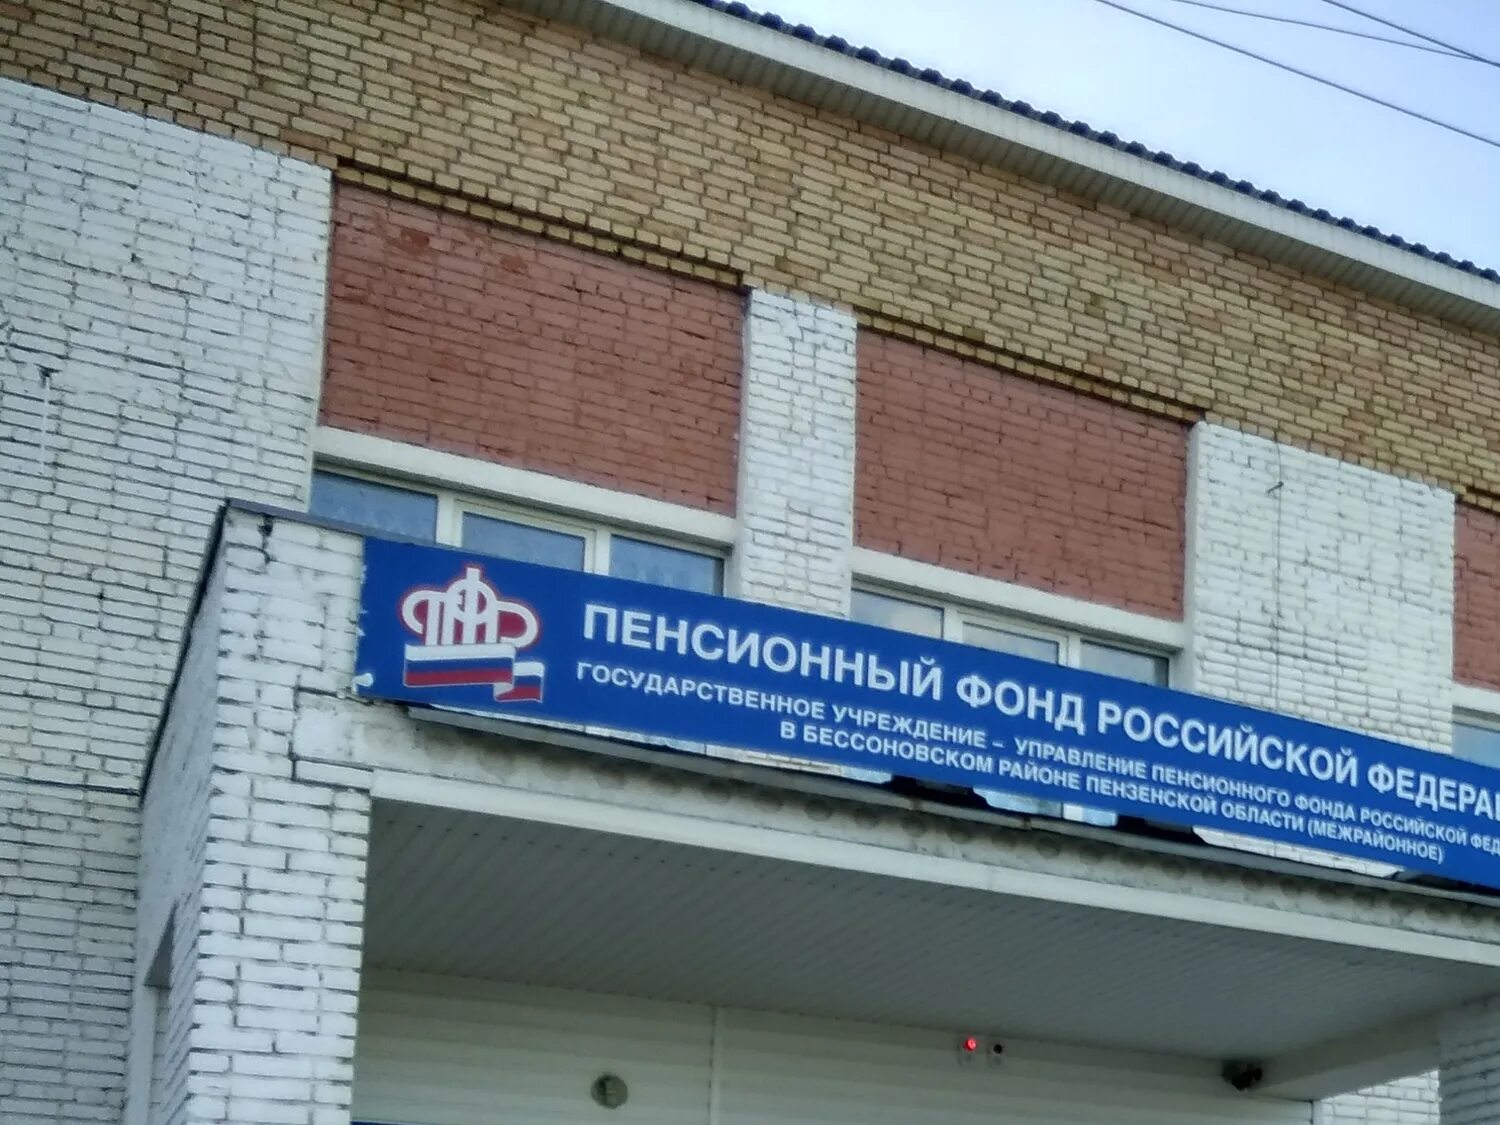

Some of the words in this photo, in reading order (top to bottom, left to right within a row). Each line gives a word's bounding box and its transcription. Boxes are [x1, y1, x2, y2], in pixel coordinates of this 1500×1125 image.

[577, 661, 826, 721] ГОСУДАРСТВЕННОЕ
[832, 704, 987, 749] УЧРЕЖДЕНИЕ
[1014, 738, 1147, 780] УПРАВЛЕНИЕ
[1151, 764, 1291, 807] ПЕНСИОННОГО
[1294, 794, 1357, 821] ФОНДА
[1360, 808, 1467, 846] РОССИЙСКОЙ
[583, 603, 943, 701] ПЕНСИОННЫЙ
[956, 674, 1086, 736] ФОНД
[1098, 700, 1358, 787] РОССИЙСКОЙ
[780, 720, 797, 739] В
[803, 724, 994, 773] БЕССОНОВСКОМ
[998, 759, 1080, 790] РАЙОНЕ
[1086, 775, 1218, 815] ПЕНЗЕНСКОЙ
[1220, 801, 1304, 832] ОБЛАСТИ
[1307, 819, 1443, 864] (МЕЖРАЙОННОЕ)
